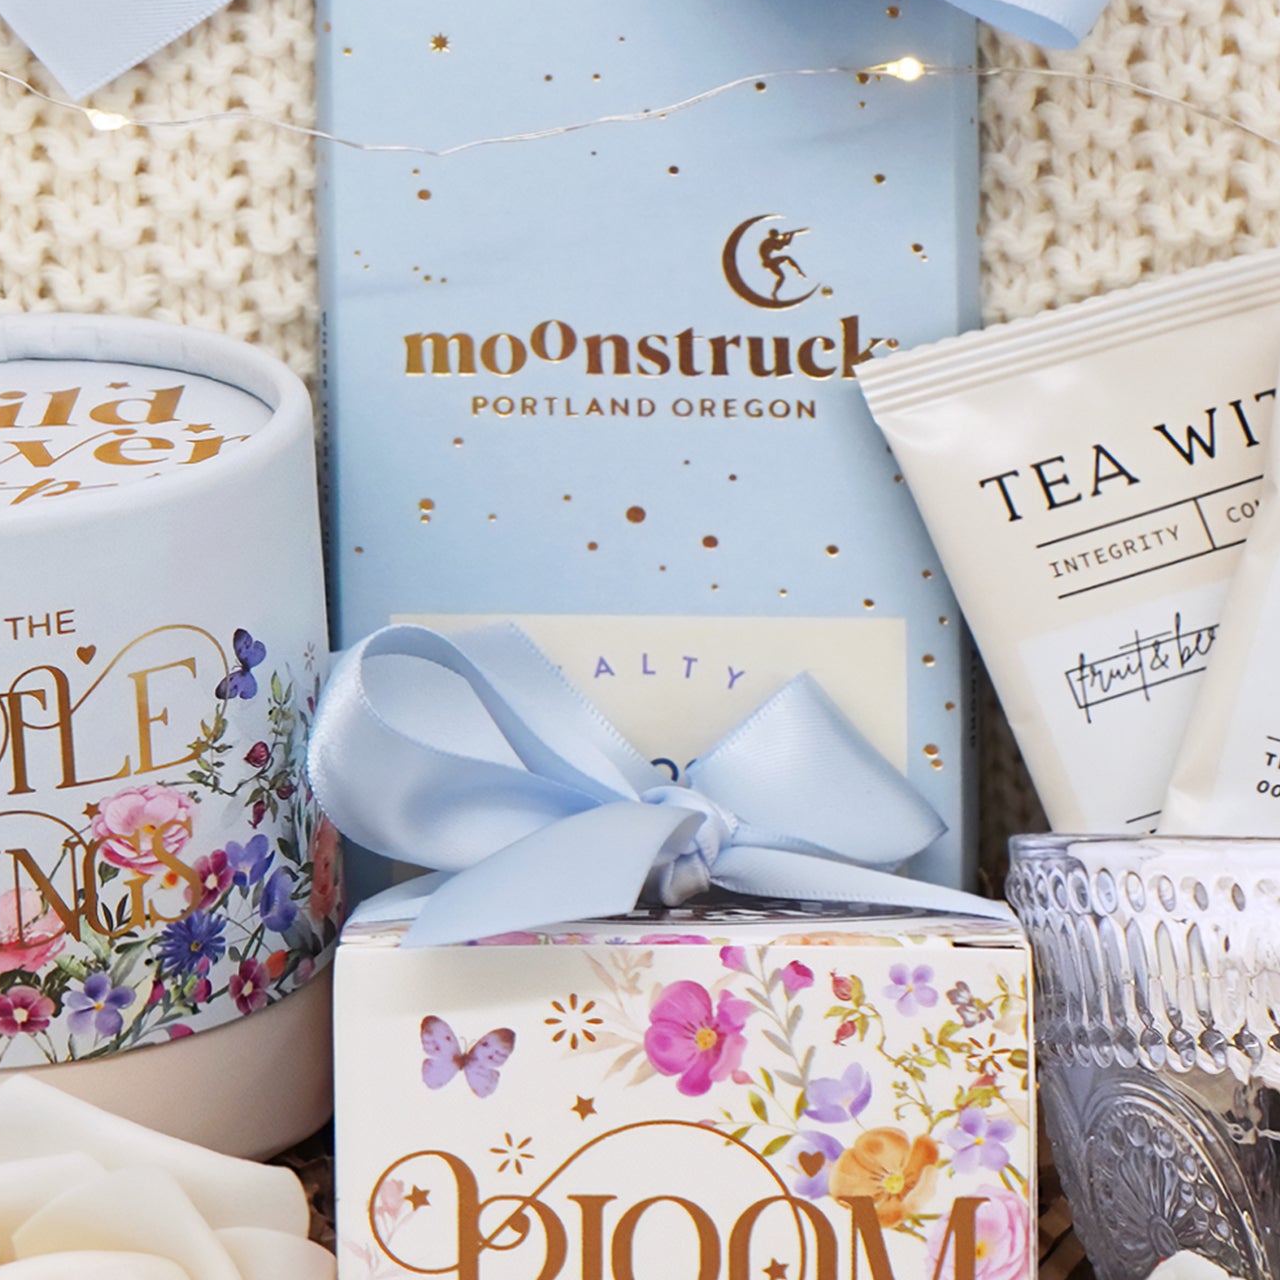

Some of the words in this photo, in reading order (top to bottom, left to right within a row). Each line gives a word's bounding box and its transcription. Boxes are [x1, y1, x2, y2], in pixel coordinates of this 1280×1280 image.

[403, 314, 899, 380] moonstruck
[471, 396, 656, 419] PORTLAND
[672, 397, 817, 419] OREGON
[978, 442, 1140, 523] TEA
[1153, 388, 1277, 466] WI
[1048, 524, 1180, 578] INTEGRITY
[4, 609, 76, 642] THE
[558, 652, 746, 690] ALTY
